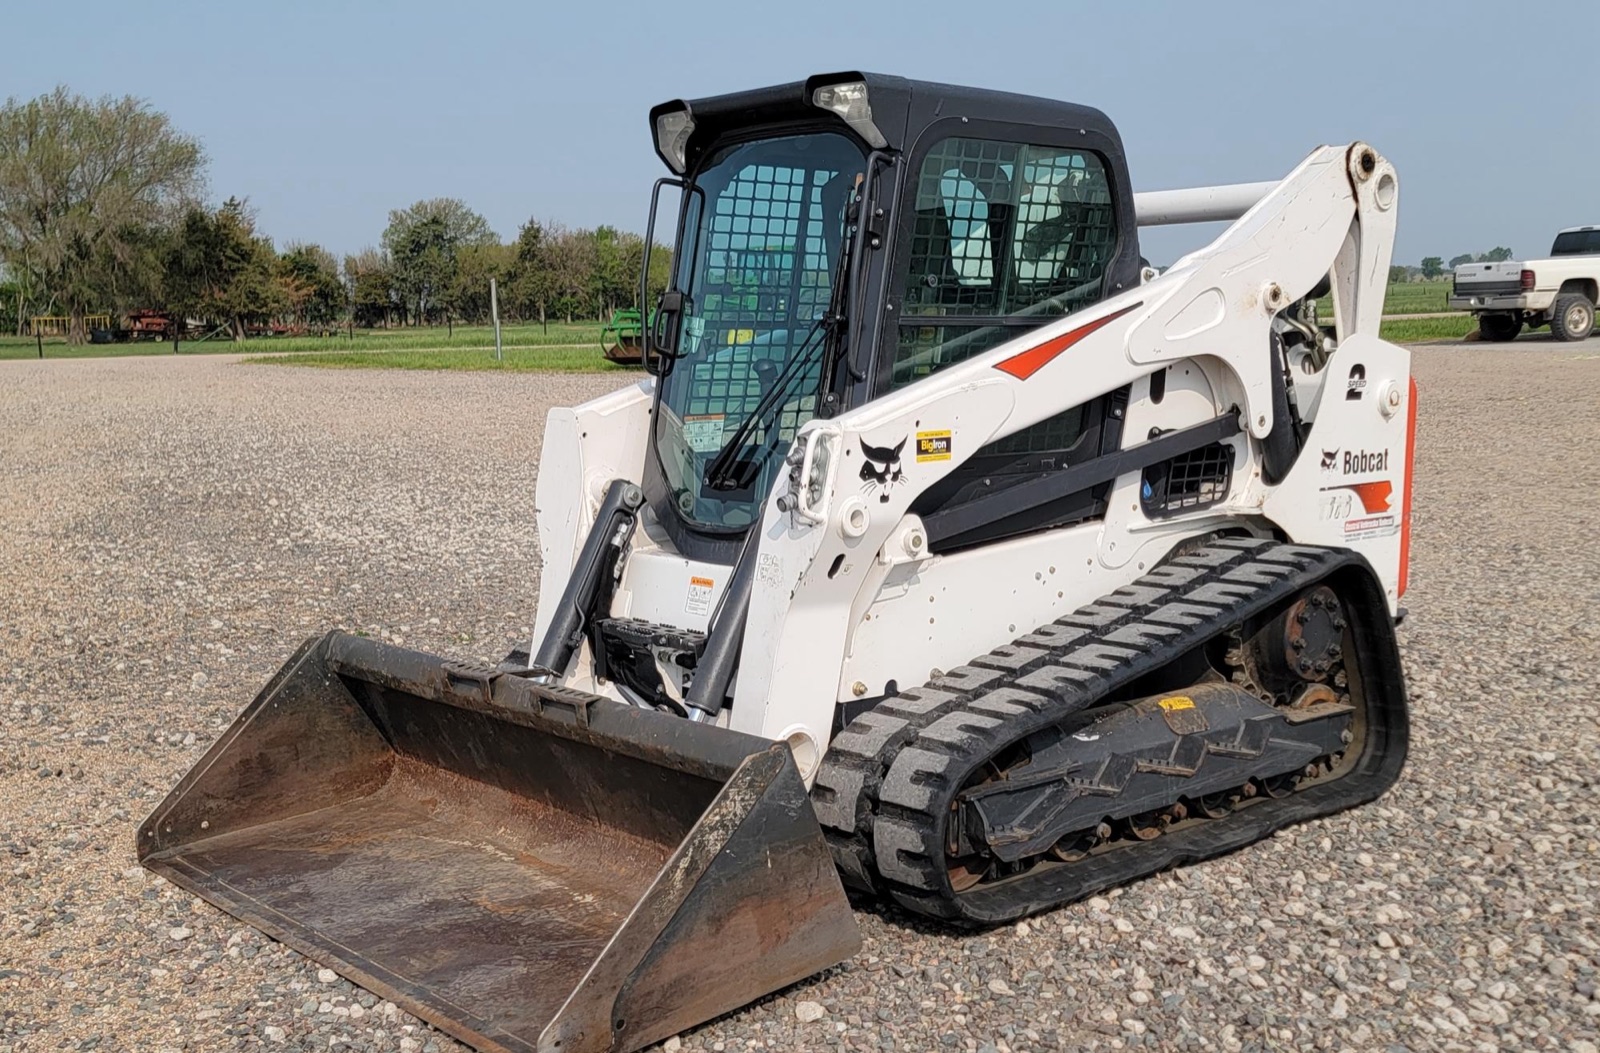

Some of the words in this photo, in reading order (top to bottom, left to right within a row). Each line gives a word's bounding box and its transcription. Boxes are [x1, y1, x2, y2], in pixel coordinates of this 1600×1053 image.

[1345, 363, 1366, 401] 2
[1347, 380, 1367, 388] SPEED
[921, 439, 946, 452] BigIron
[1343, 448, 1388, 475] Bobcat
